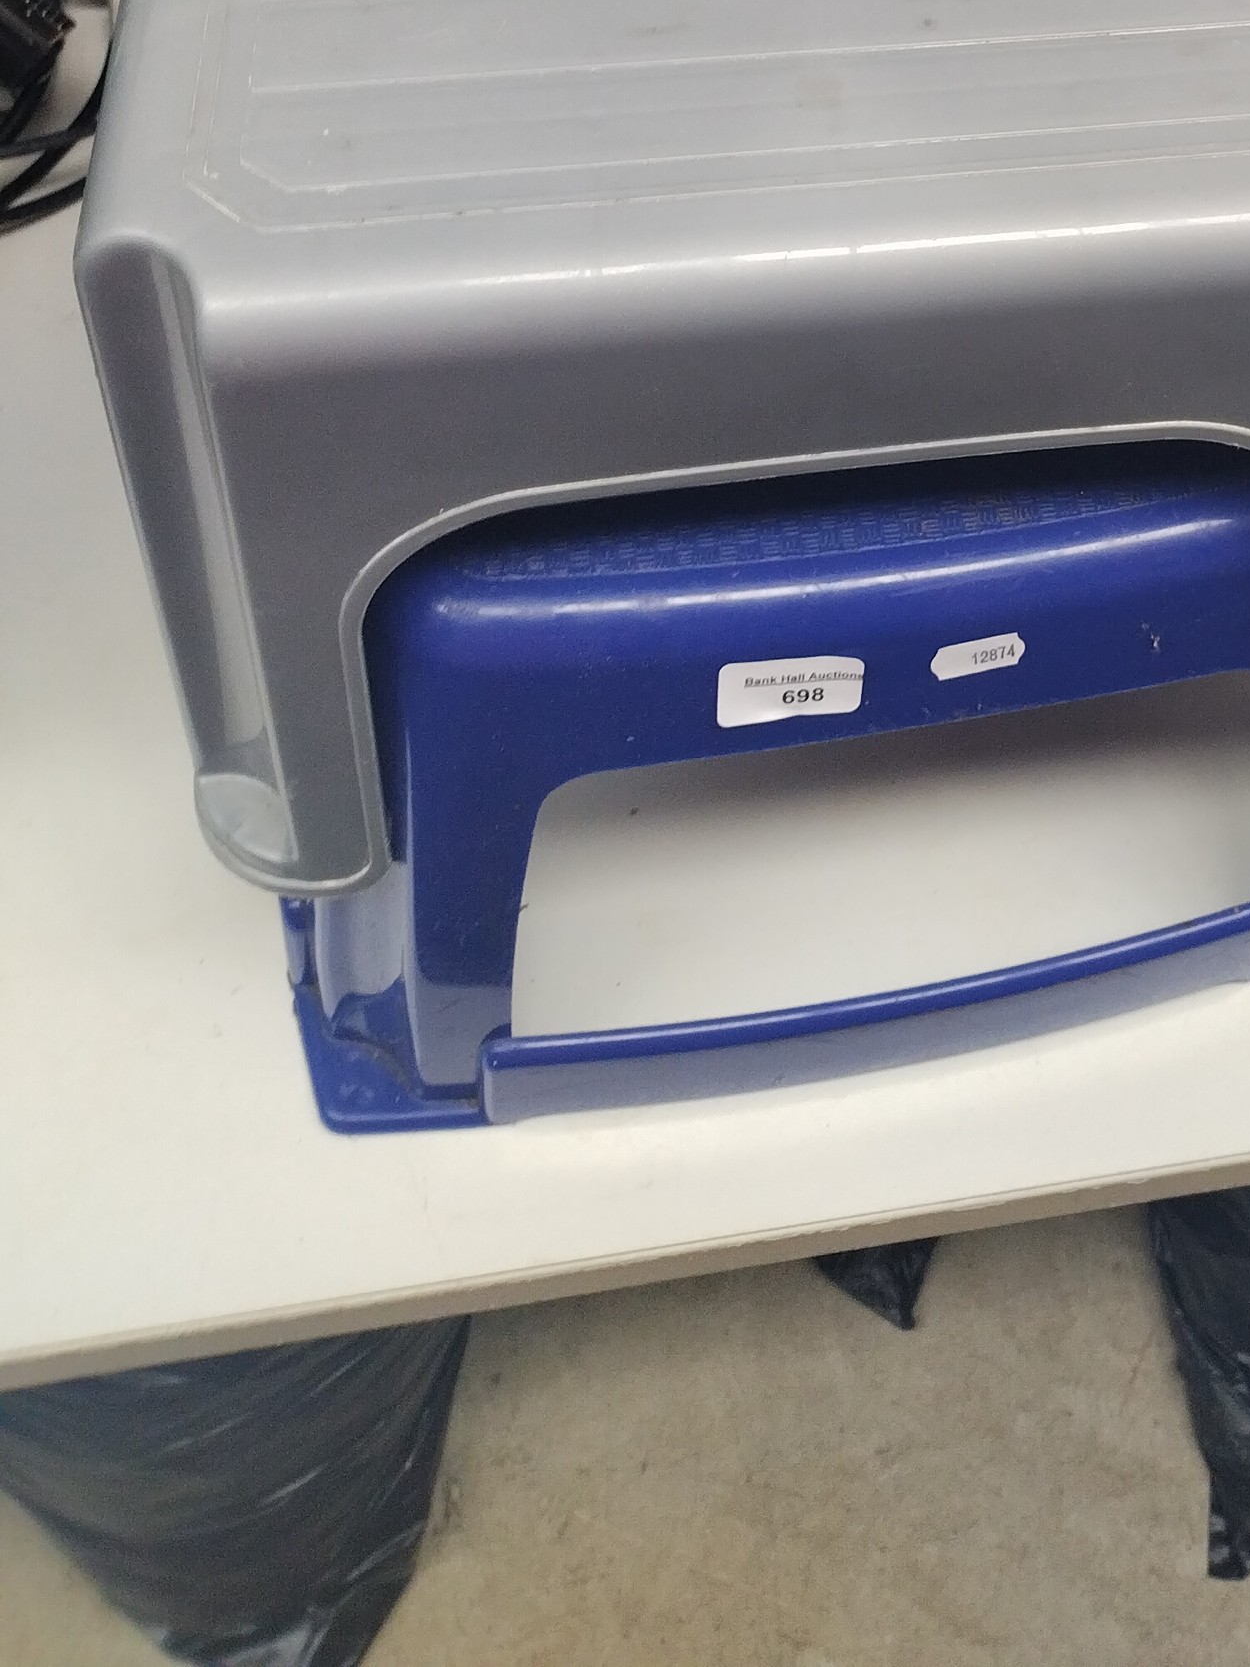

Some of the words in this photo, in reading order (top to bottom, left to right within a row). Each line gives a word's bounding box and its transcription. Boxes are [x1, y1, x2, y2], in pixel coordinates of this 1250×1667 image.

[971, 643, 1017, 666] 12874
[743, 675, 777, 688] Bank
[780, 672, 806, 685] Hall
[781, 686, 825, 705] 698
